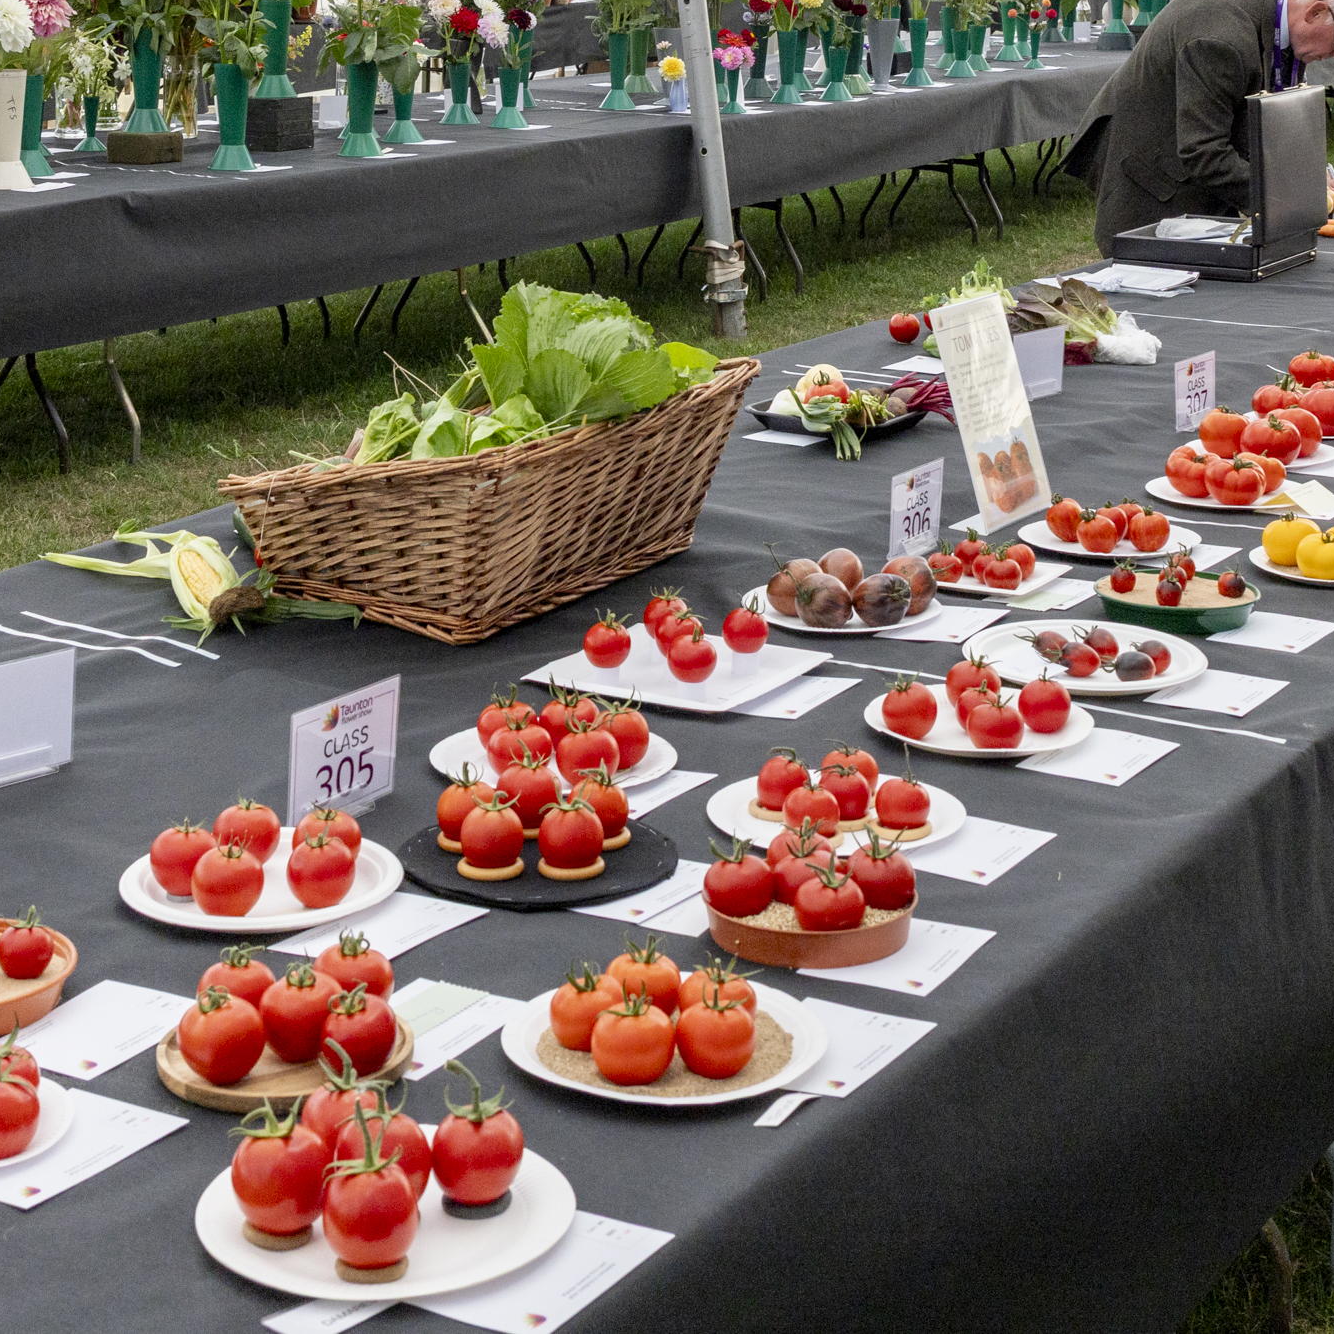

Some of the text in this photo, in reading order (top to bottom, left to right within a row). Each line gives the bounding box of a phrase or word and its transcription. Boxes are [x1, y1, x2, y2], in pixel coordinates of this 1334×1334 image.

[952, 325, 1000, 353] TOMATOES
[1187, 376, 1206, 392] CLASS
[1186, 389, 1208, 418] 307
[907, 490, 929, 511] CLASS
[903, 507, 931, 541] 306
[340, 696, 373, 716] Taunton
[341, 708, 373, 725] flower show
[323, 725, 369, 758] CLASS
[315, 746, 375, 803] 305
